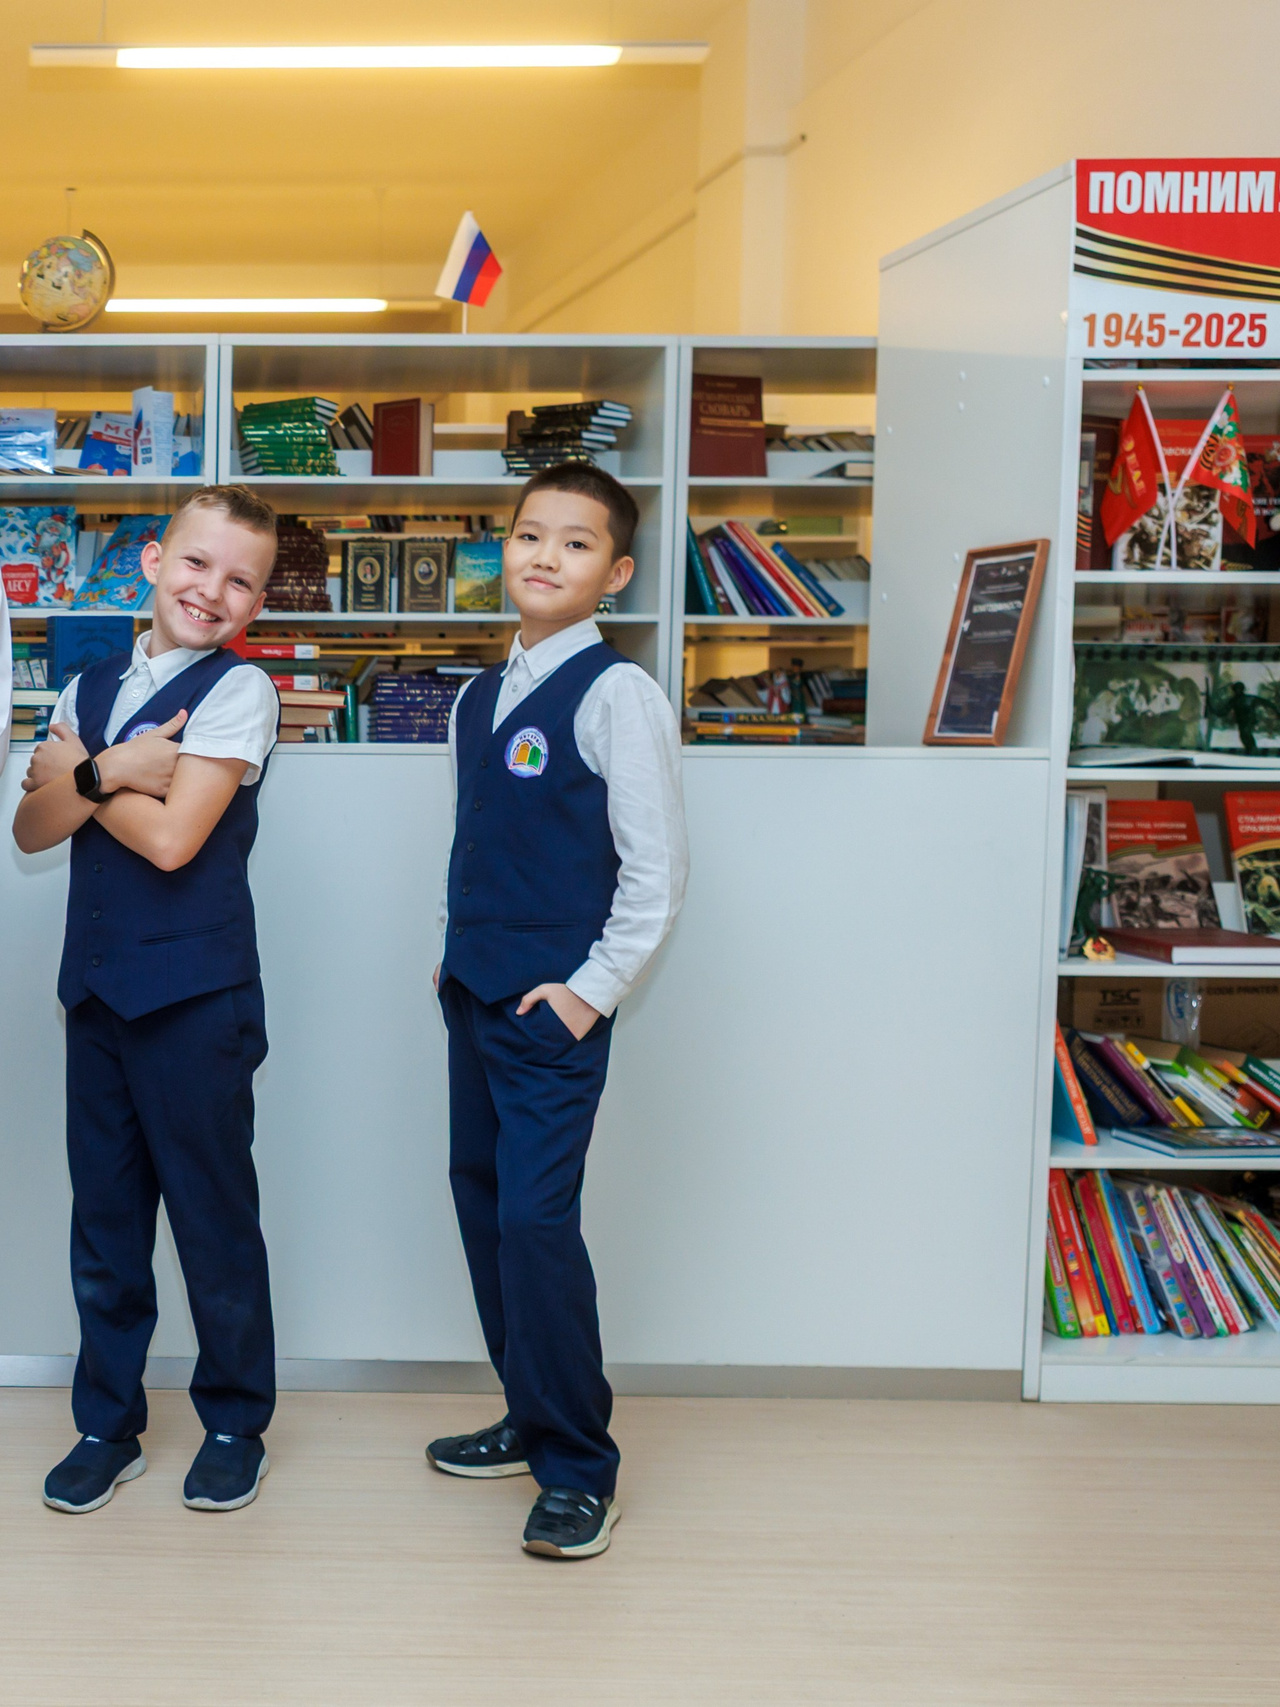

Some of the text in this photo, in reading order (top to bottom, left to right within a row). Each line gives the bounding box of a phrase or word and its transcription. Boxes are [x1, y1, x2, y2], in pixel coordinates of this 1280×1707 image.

[1088, 170, 1280, 214] ПОМНИМ
[1083, 312, 1268, 348] 1945-2025
[1099, 989, 1141, 1004] TSC
